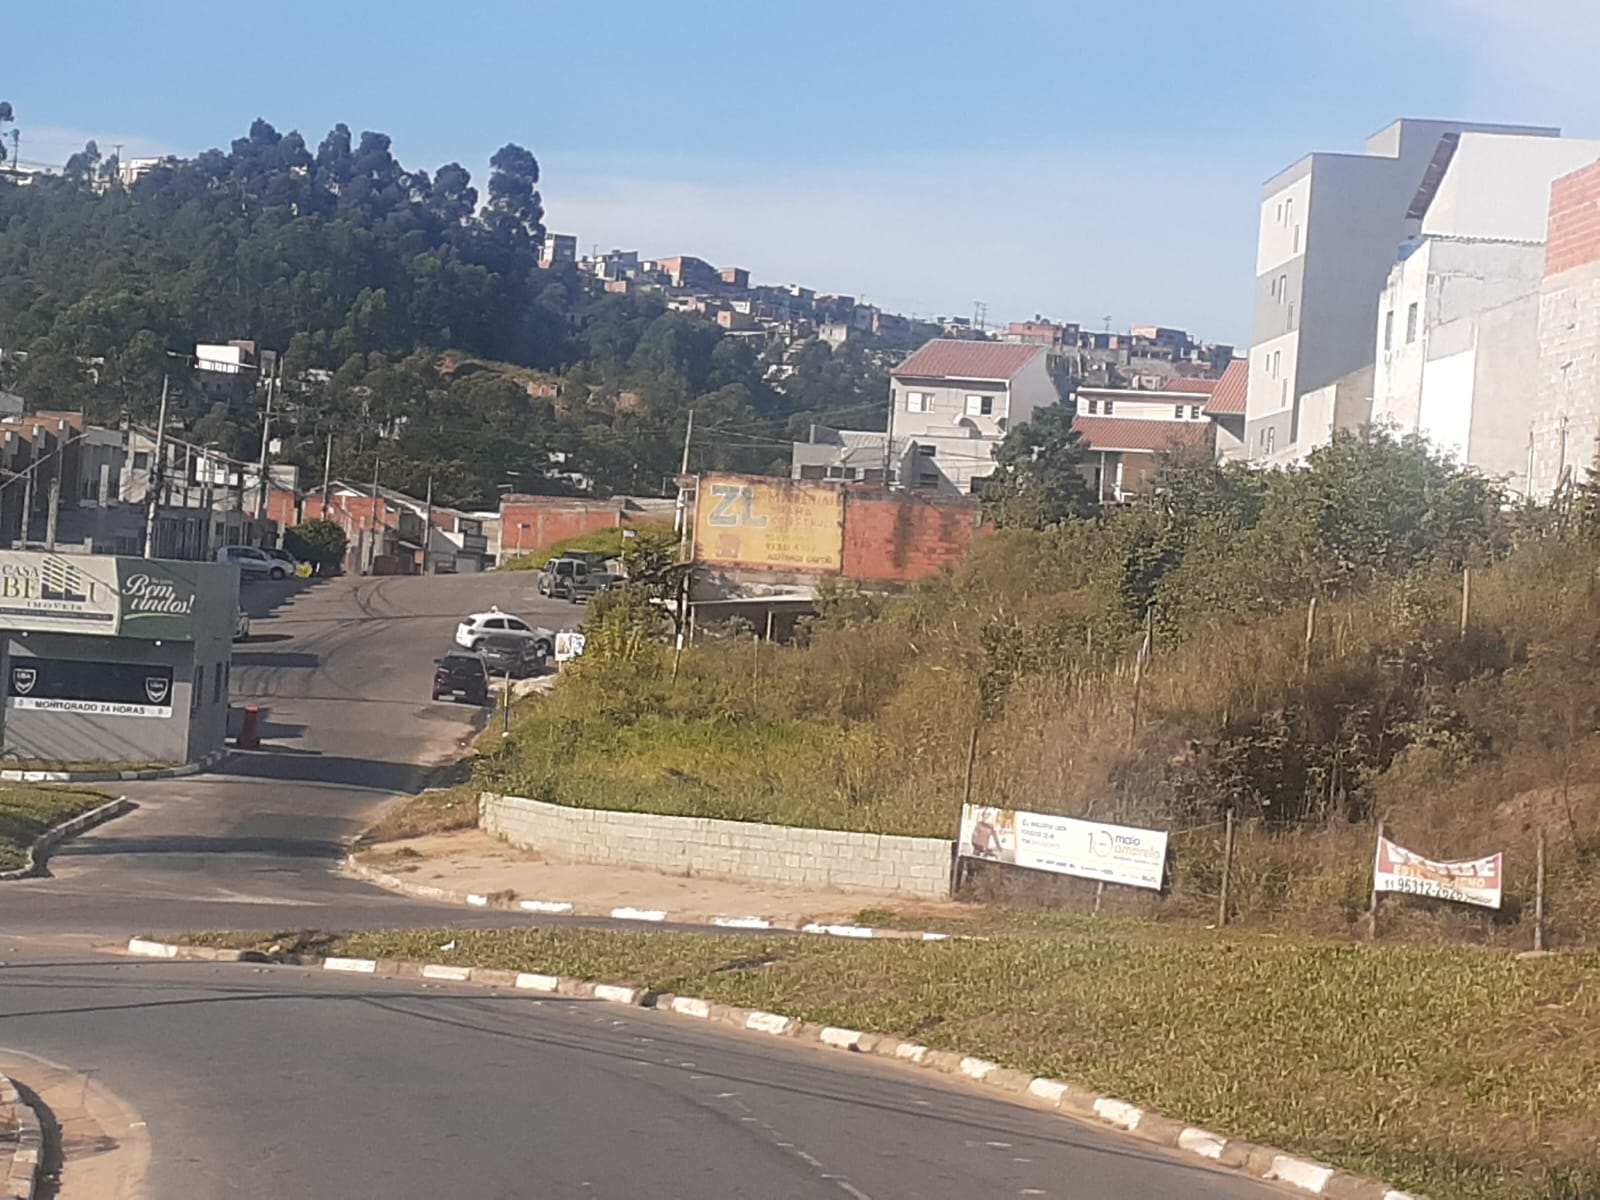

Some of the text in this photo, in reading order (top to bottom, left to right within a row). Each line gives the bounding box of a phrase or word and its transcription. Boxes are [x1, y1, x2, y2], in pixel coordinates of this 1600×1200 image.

[707, 485, 768, 528] ZL
[2, 564, 39, 577] CASA
[122, 574, 173, 598] Bem
[130, 593, 195, 614] vindos!
[35, 701, 98, 712] MONITORADO
[113, 705, 145, 715] HORAS
[1115, 834, 1141, 846] maio
